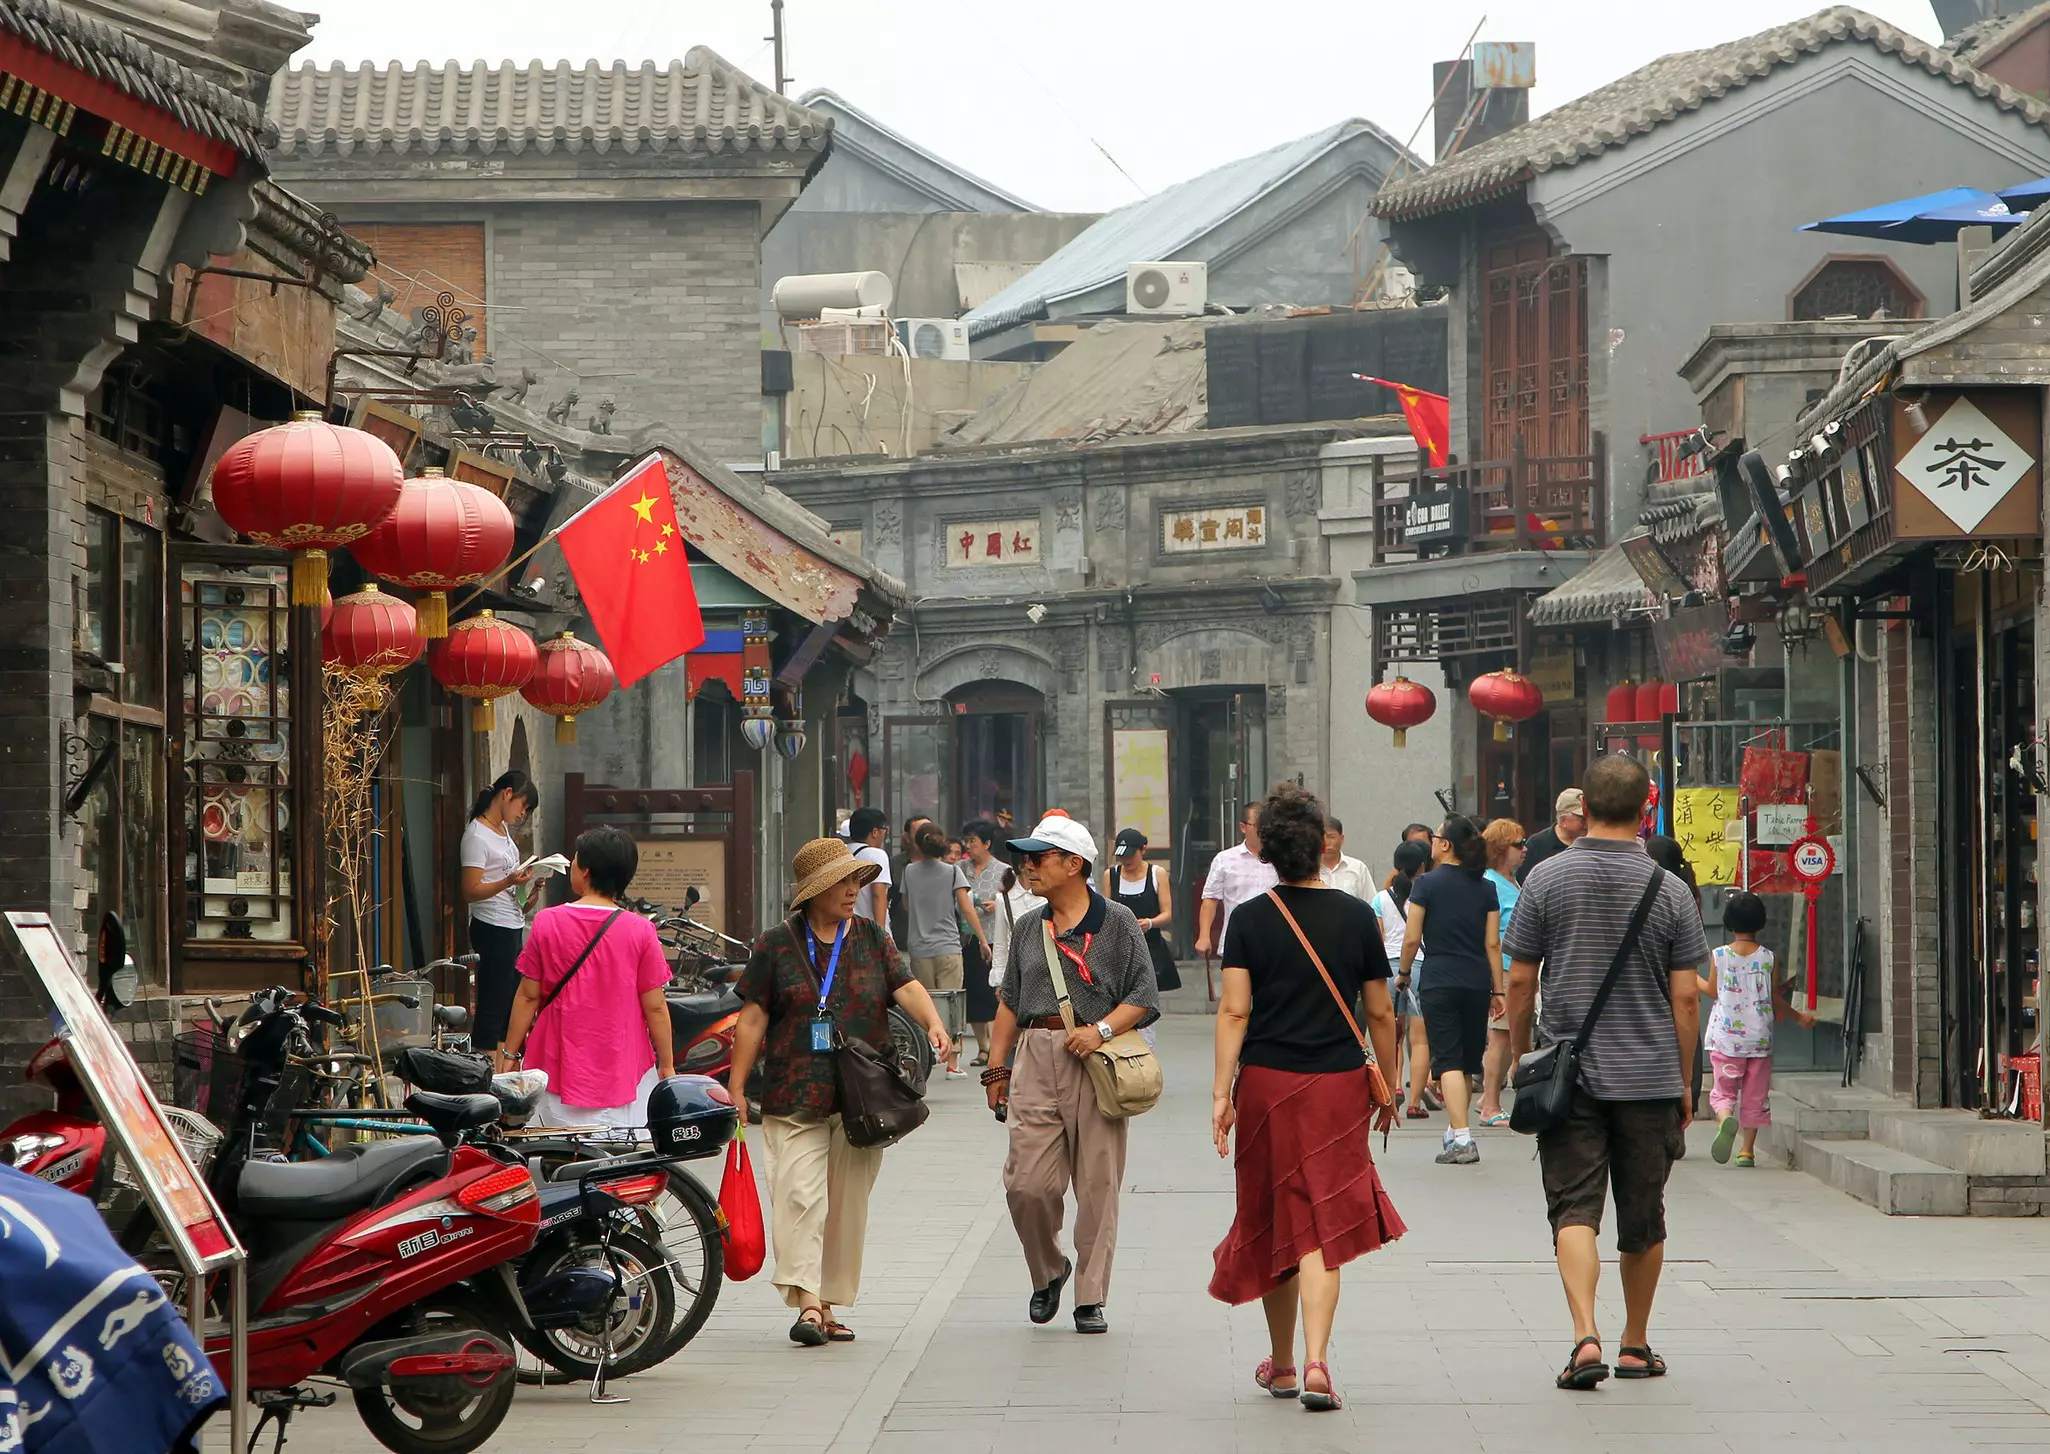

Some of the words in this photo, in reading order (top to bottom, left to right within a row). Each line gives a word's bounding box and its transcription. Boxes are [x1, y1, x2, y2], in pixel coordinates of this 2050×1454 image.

[1926, 437, 2006, 491] 茶
[1121, 738, 1164, 838] 烟斗
[1801, 856, 1823, 866] VISA
[397, 1229, 440, 1259] 新日
